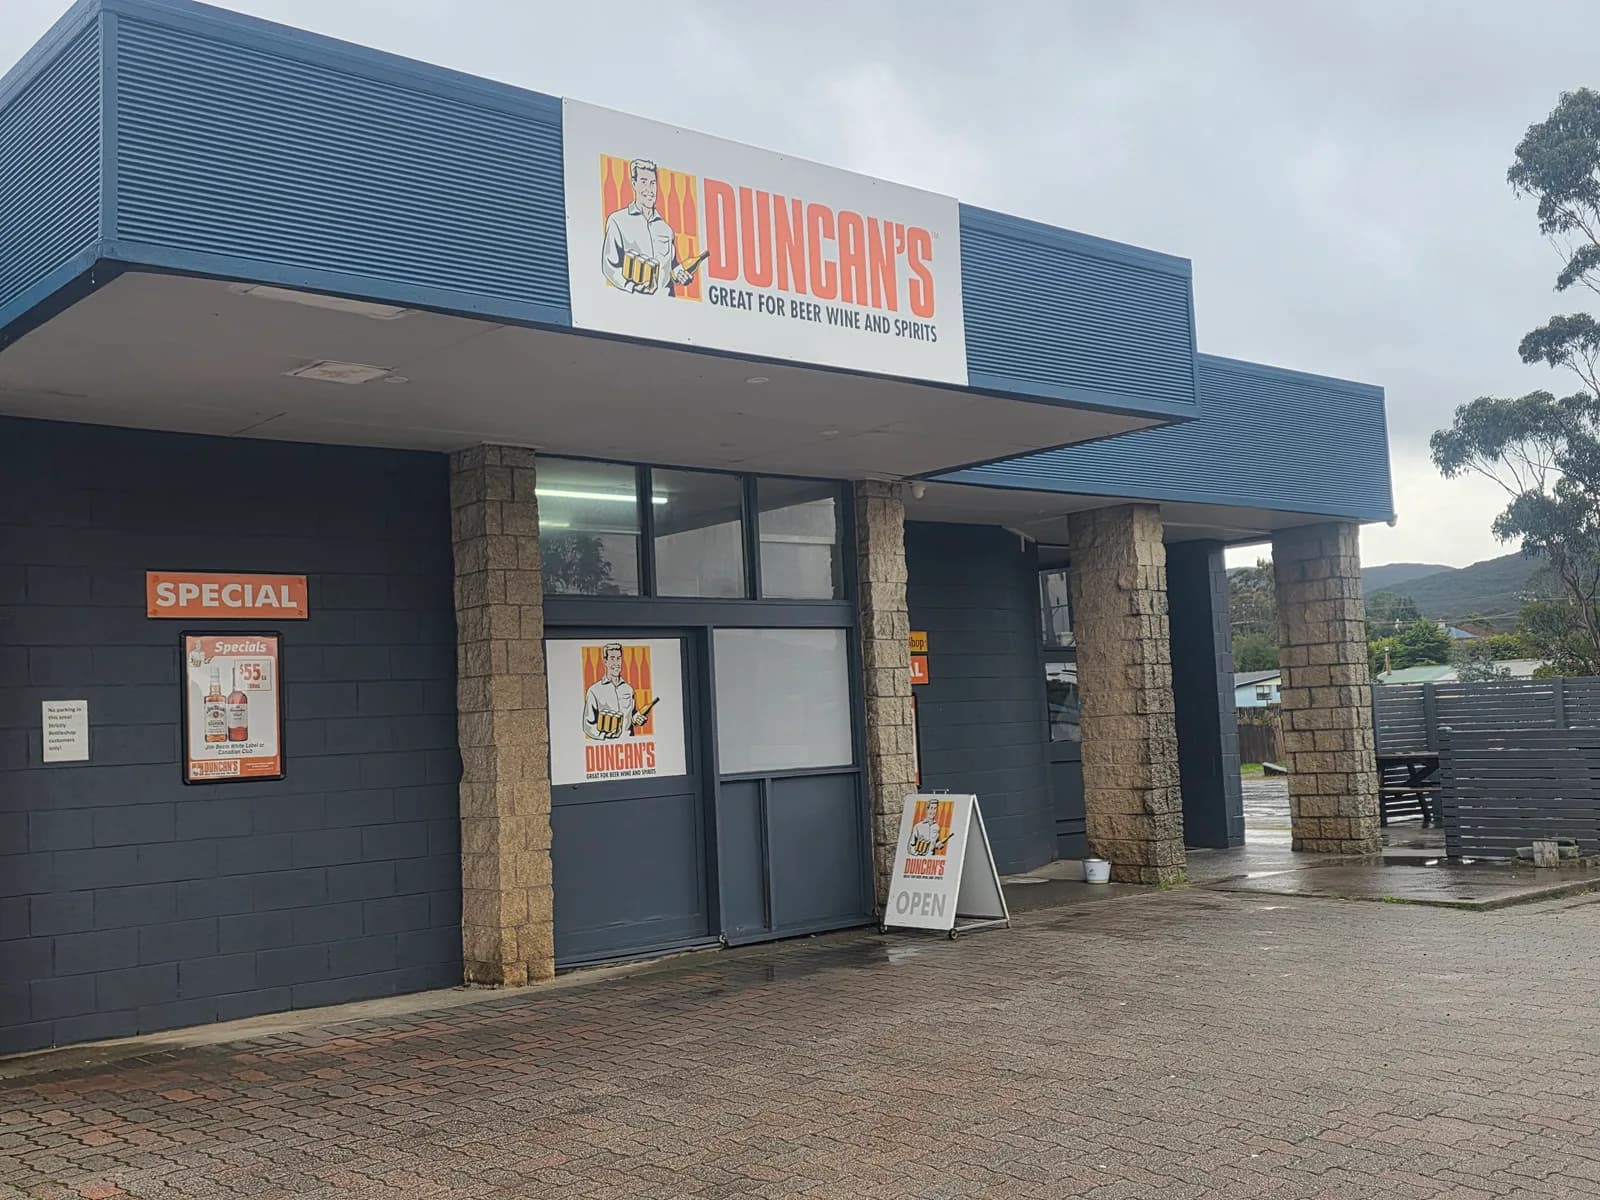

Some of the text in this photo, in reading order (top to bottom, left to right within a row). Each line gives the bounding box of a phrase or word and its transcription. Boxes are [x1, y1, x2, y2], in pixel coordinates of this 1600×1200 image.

[704, 178, 935, 319] DUNCAN'S
[708, 285, 937, 343] GREAT FOR BEER WINE AND SPIRITS
[155, 582, 298, 608] SPECIAL
[214, 640, 267, 655] Specials
[204, 760, 238, 773] DUNCAN'S
[585, 741, 656, 772] DUNCAN'S
[904, 858, 945, 876] DUNCAN'S
[896, 890, 946, 917] OPEN
